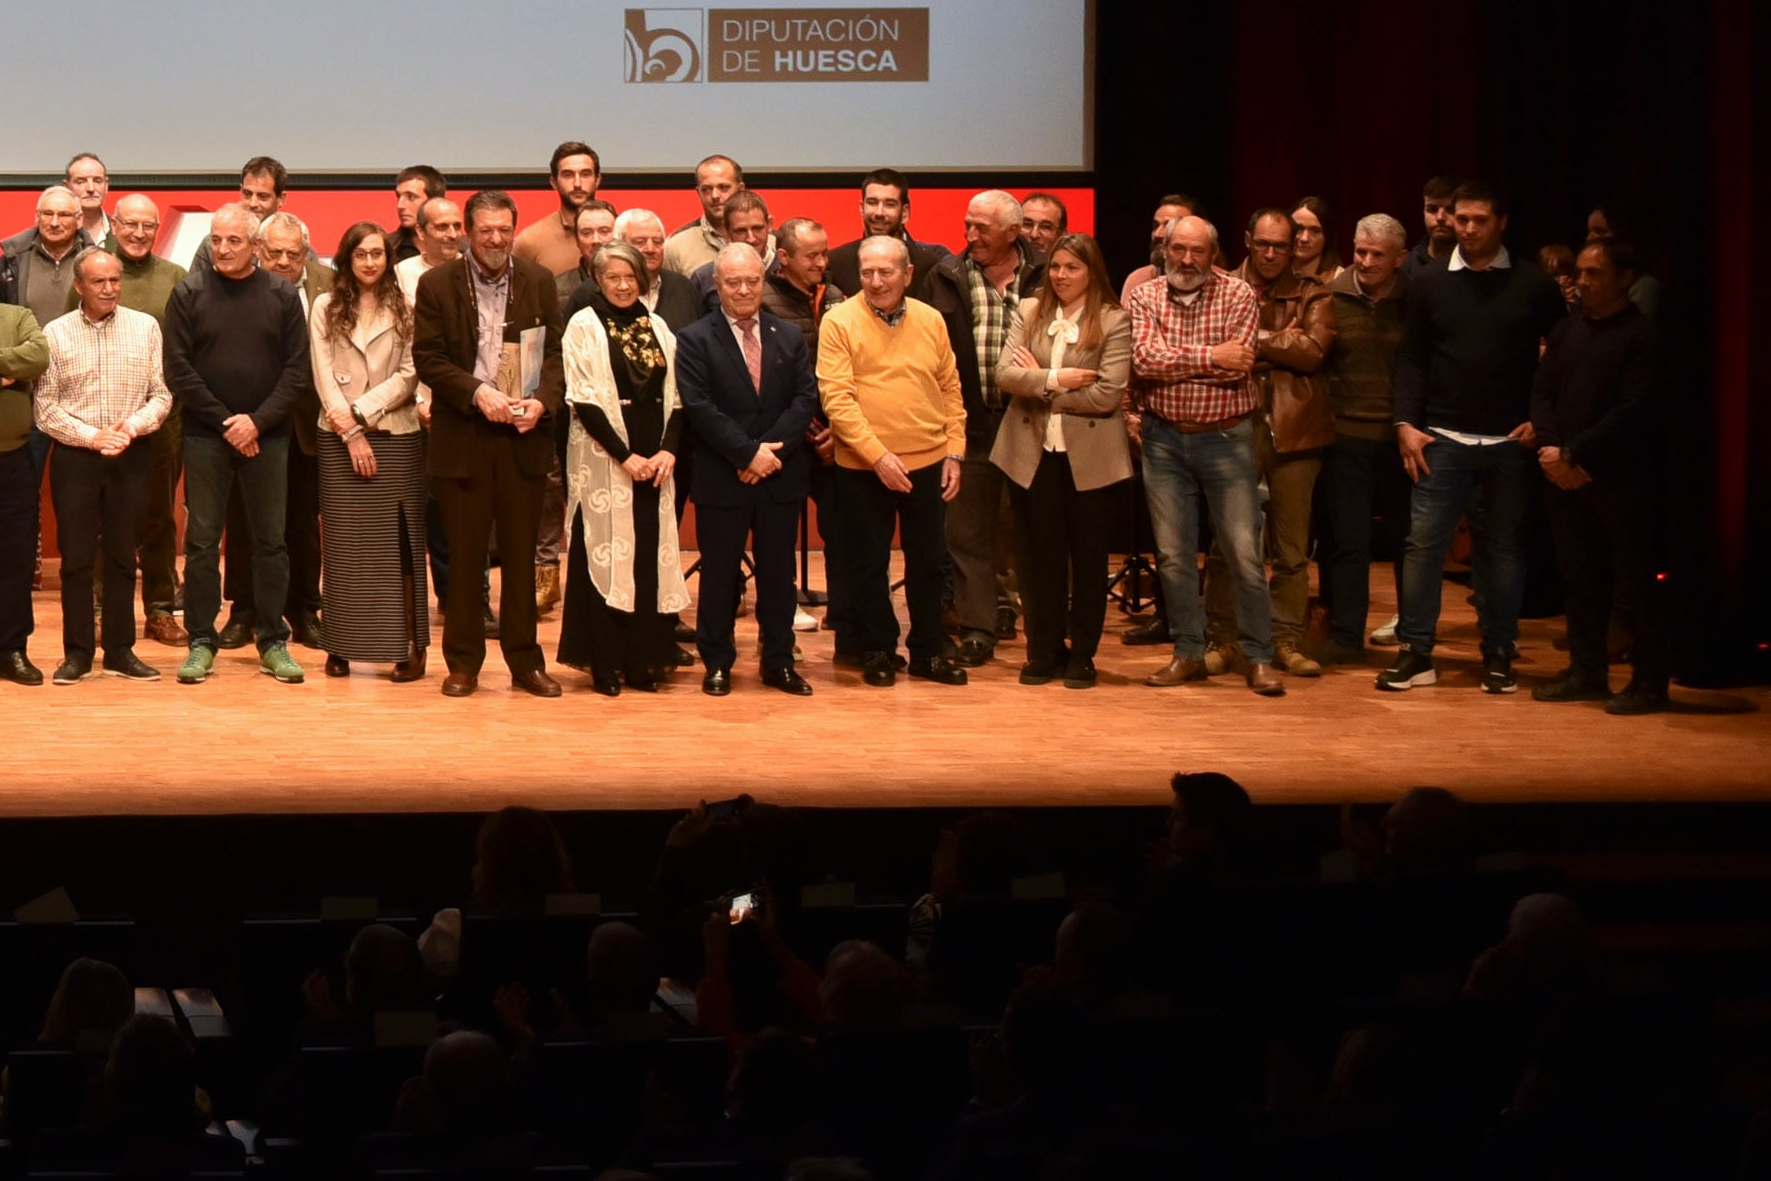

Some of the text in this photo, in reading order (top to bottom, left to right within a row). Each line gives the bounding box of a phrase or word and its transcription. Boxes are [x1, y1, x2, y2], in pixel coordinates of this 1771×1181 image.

[722, 14, 900, 43] DIPUTACIÓN
[723, 49, 899, 73] DE HUESCA
